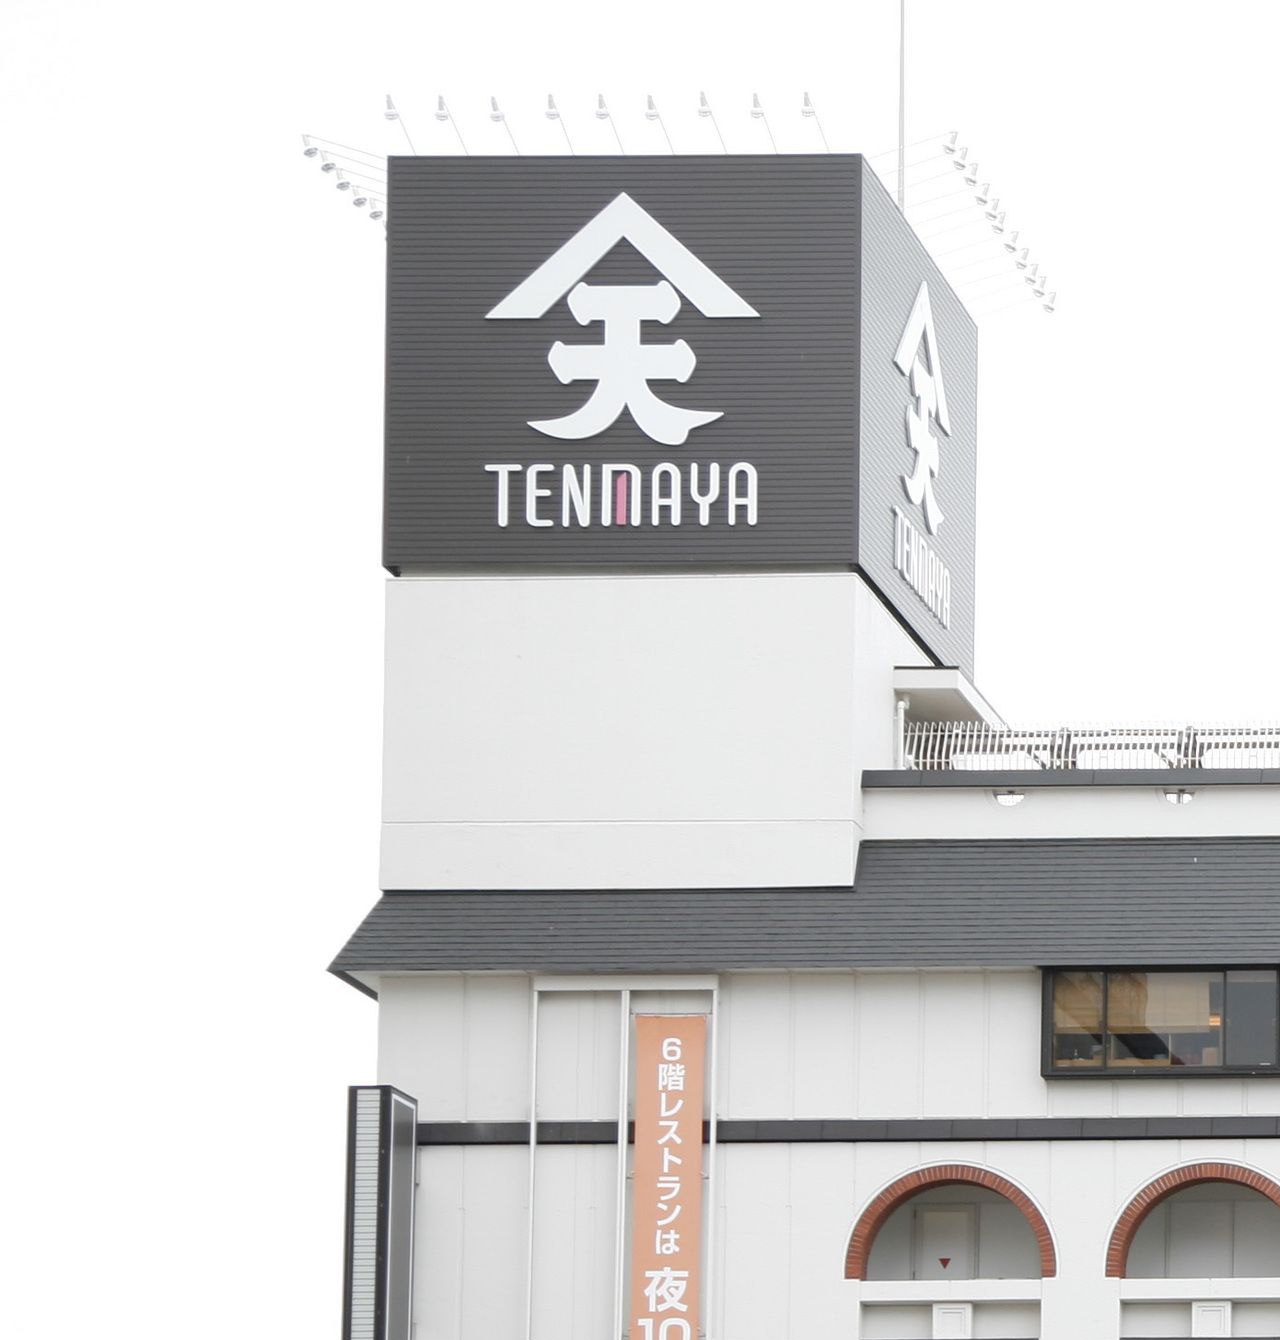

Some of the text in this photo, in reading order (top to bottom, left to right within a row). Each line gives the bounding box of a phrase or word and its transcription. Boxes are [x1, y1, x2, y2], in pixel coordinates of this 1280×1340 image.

[485, 461, 759, 528] TENMAYA
[891, 504, 951, 630] TENMAYA
[655, 1036, 685, 1256] 6階レストランは
